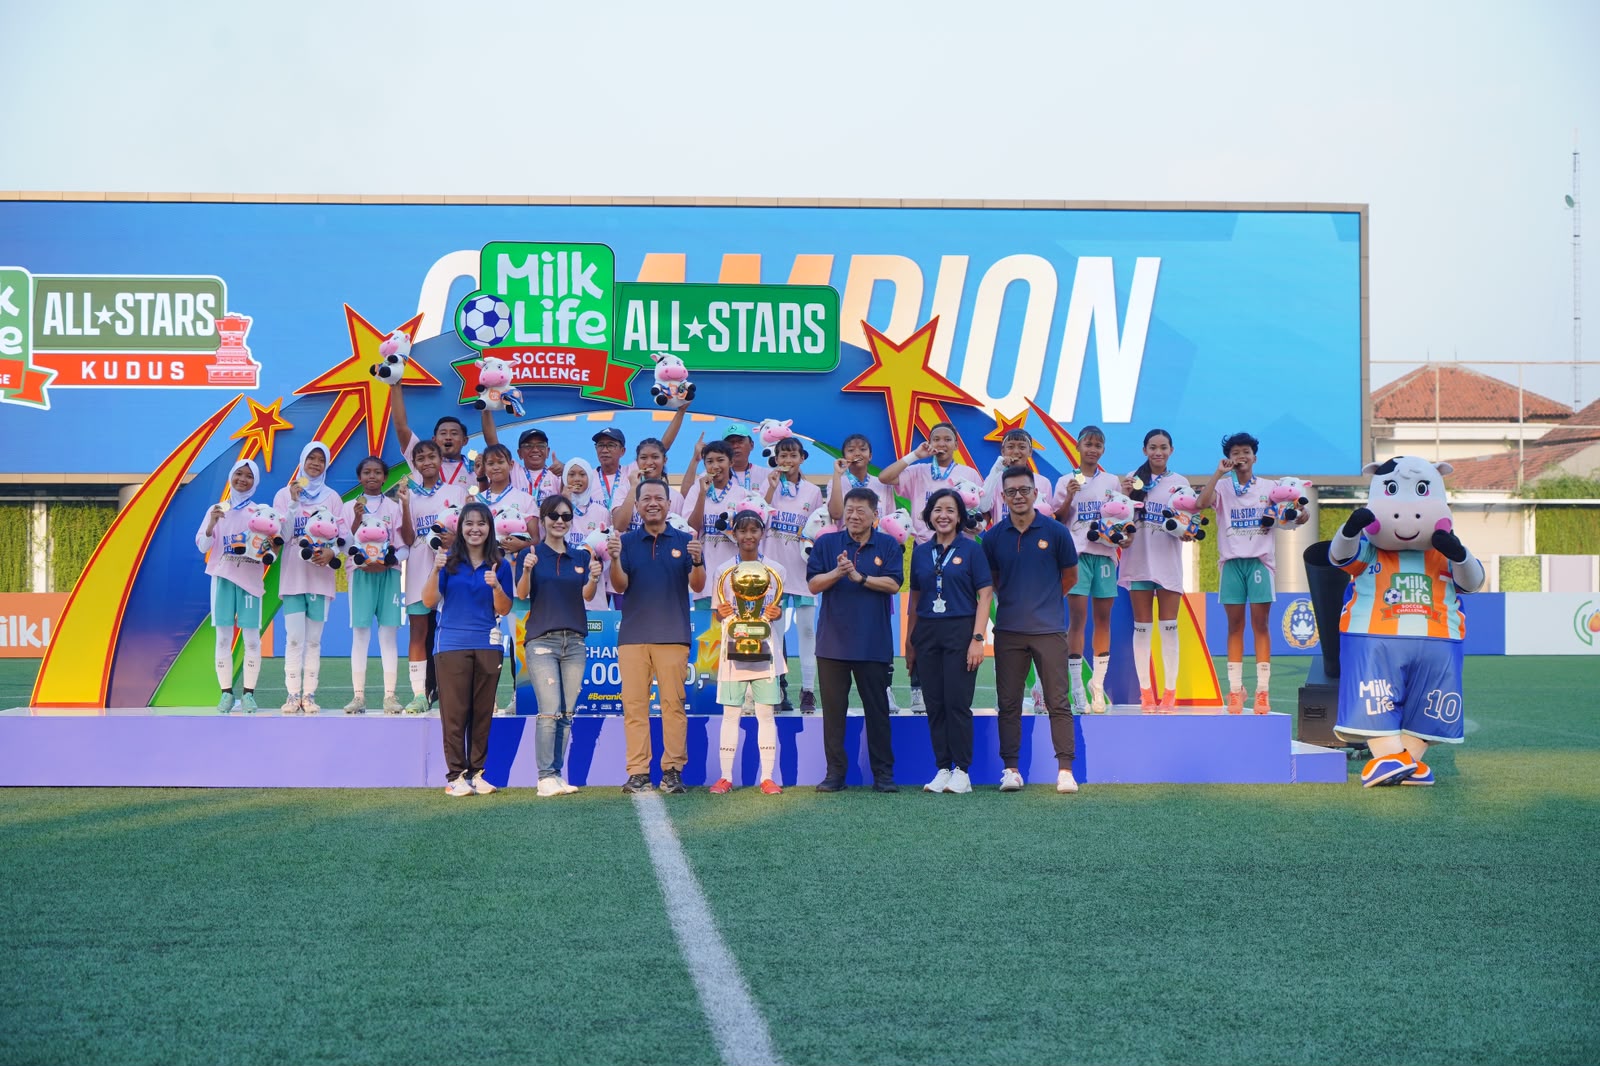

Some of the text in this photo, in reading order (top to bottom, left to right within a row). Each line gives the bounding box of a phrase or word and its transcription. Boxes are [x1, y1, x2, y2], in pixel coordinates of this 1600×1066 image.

[496, 251, 604, 299] Milk
[42, 292, 100, 335] ALL
[114, 292, 216, 336] STARS
[514, 298, 607, 345] Life
[622, 299, 826, 354] ALL STARS
[512, 352, 576, 366] SOCCER
[81, 360, 185, 380] KUDUS
[511, 367, 591, 382] HALLENGE
[1232, 519, 1260, 527] KUDUS
[1100, 564, 1112, 578] 10
[1368, 562, 1382, 575] 10
[1254, 570, 1263, 584] 6
[1395, 575, 1429, 592] Milk
[245, 594, 253, 608] 11
[392, 593, 400, 607] 4
[1401, 589, 1432, 605] Life
[1293, 613, 1313, 622] PSSI
[1359, 679, 1394, 698] Milk
[1365, 696, 1395, 716] Life
[1424, 689, 1462, 724] 10
